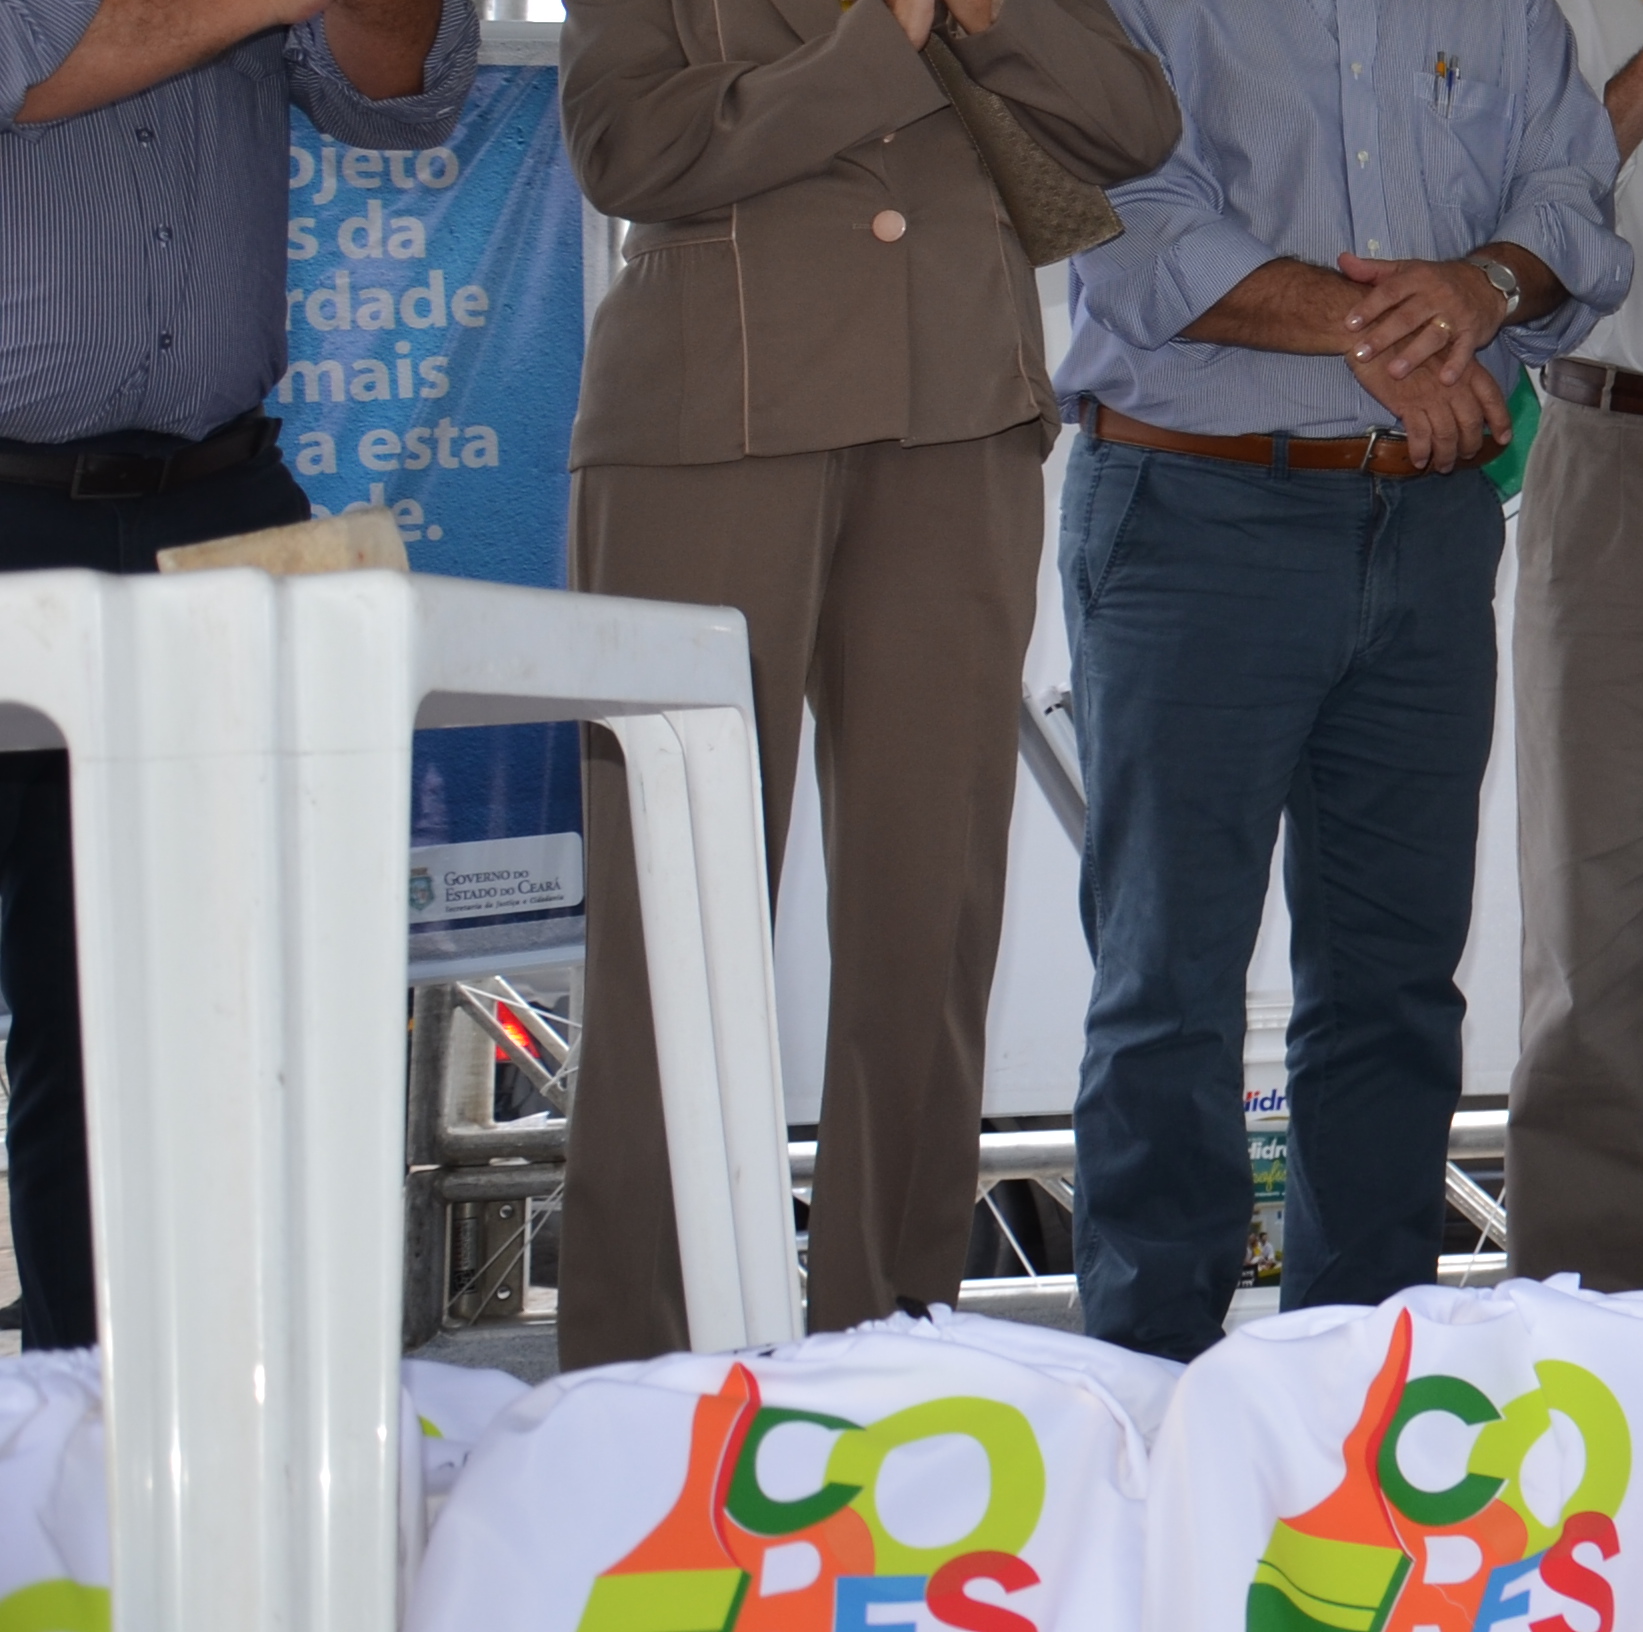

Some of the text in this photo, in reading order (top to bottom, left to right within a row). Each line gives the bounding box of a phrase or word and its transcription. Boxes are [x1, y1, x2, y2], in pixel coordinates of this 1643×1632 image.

[338, 199, 426, 260] da
[278, 341, 451, 405] mais
[358, 416, 500, 471] esta
[444, 870, 511, 887] GOVERNO
[445, 887, 497, 902] ESTADO
[518, 877, 561, 895] CEARÁ
